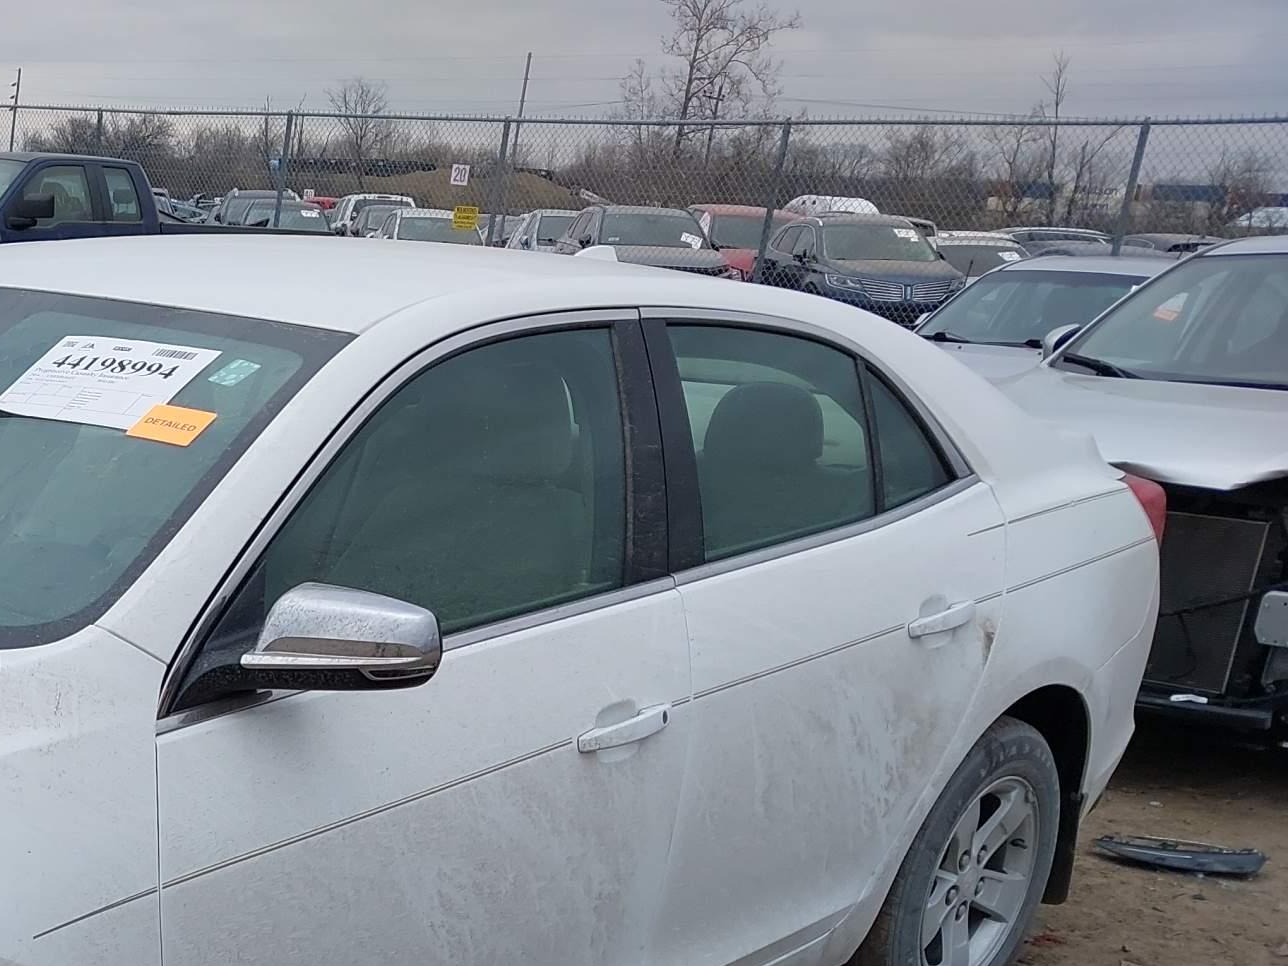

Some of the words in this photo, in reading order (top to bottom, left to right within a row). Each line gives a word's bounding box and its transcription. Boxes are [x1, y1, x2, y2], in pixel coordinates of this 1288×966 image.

[453, 166, 467, 183] 20
[52, 354, 180, 379] 44198994
[144, 416, 198, 432] DETAILED
